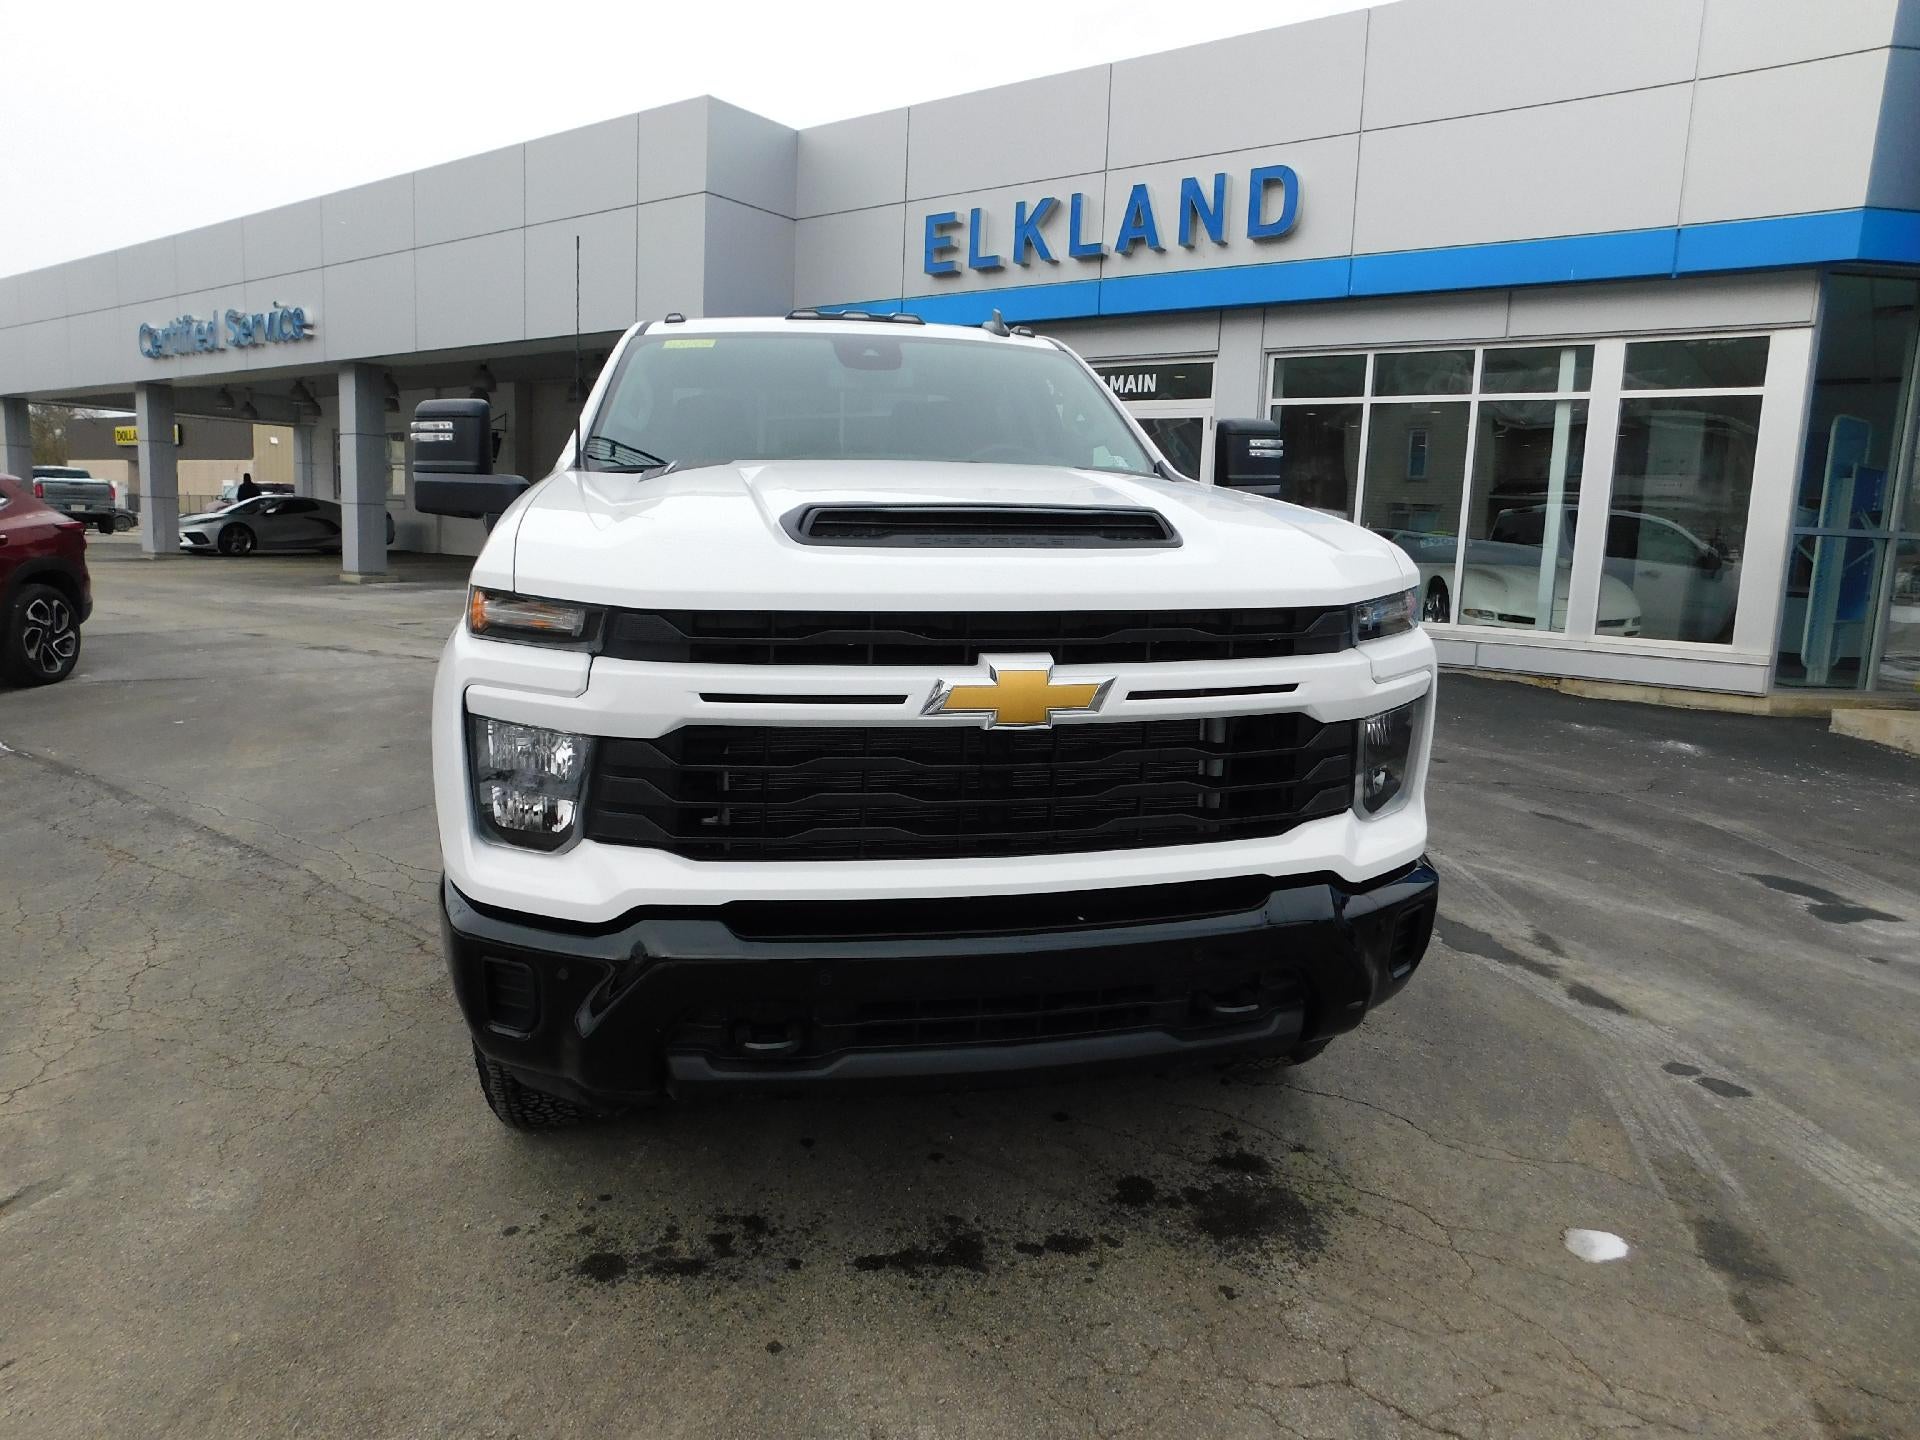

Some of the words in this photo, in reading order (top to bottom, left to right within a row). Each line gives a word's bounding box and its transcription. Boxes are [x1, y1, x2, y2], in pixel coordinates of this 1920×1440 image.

[924, 164, 1300, 276] ELKLAND
[139, 308, 221, 359] Certified
[224, 301, 307, 349] Service
[1110, 374, 1157, 393] MAIN
[914, 536, 1081, 546] CHEVROLET
